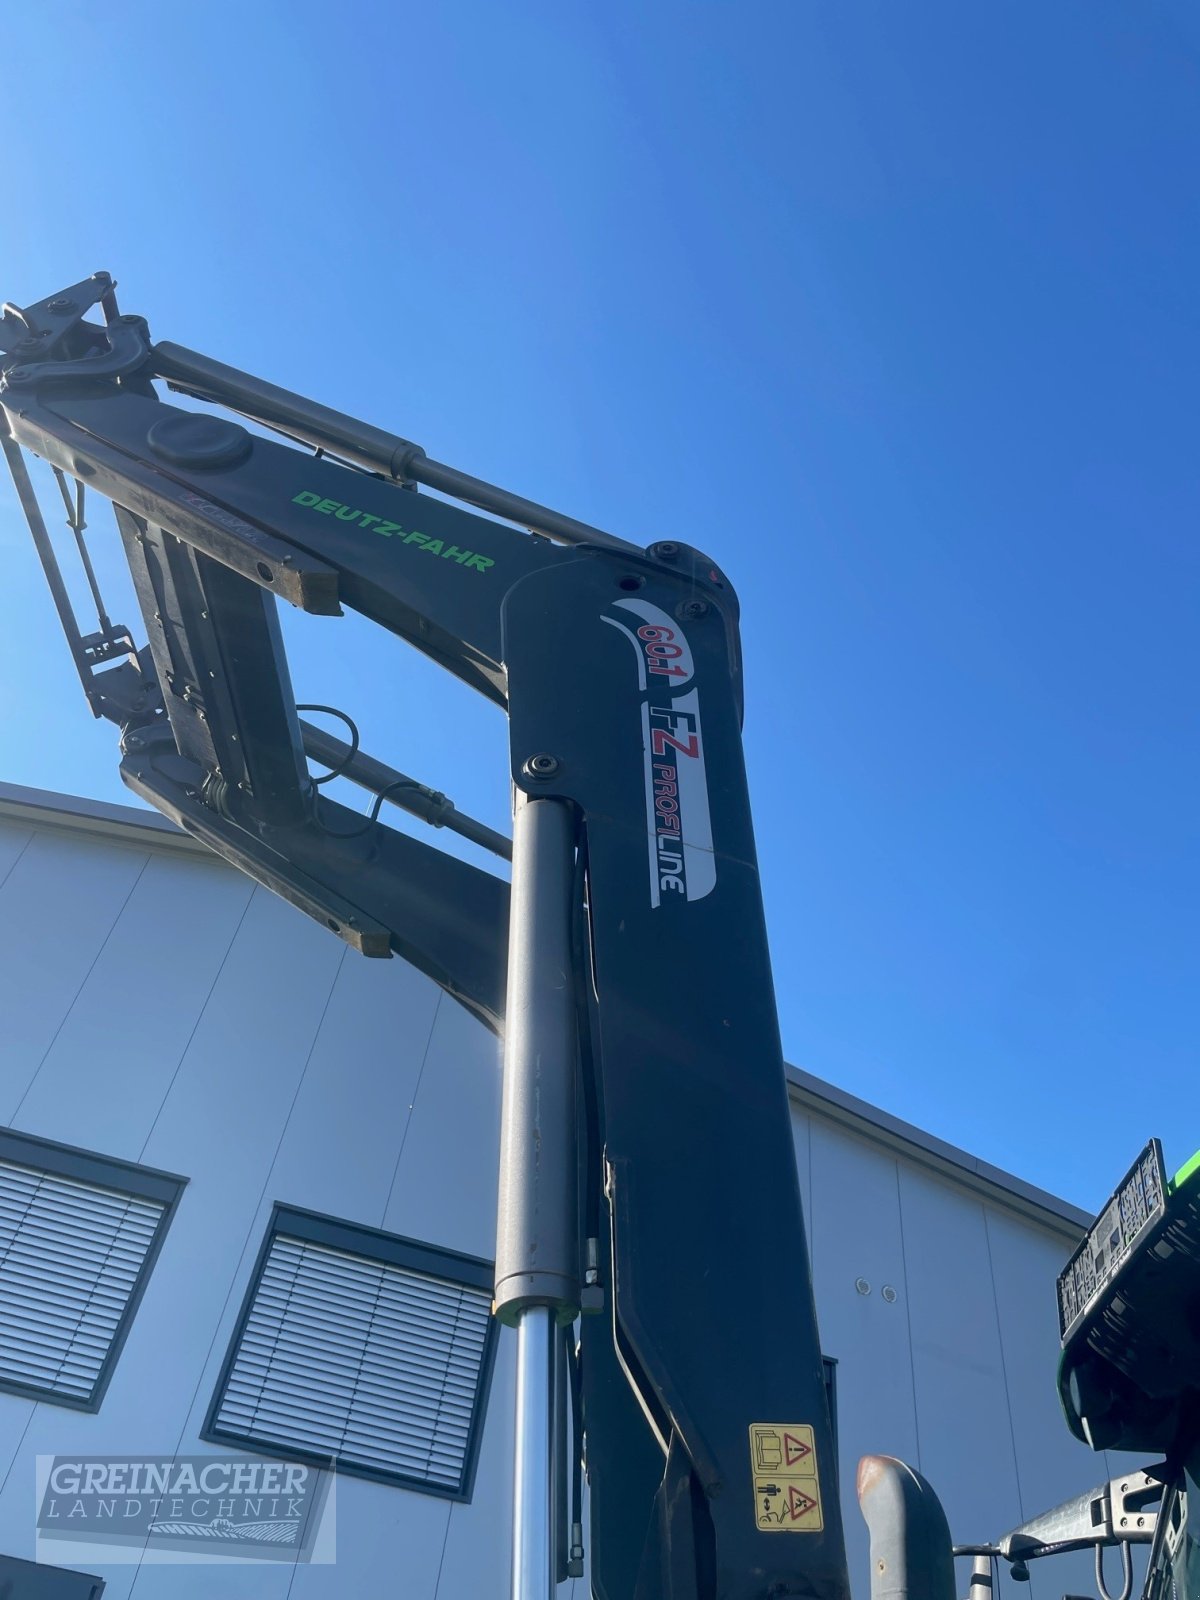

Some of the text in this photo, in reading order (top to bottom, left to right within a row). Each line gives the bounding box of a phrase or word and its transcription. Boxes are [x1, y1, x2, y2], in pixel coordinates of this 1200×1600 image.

[292, 491, 495, 572] DEUTZ-FAHR
[637, 625, 688, 677] 60.1
[651, 706, 699, 758] FZ
